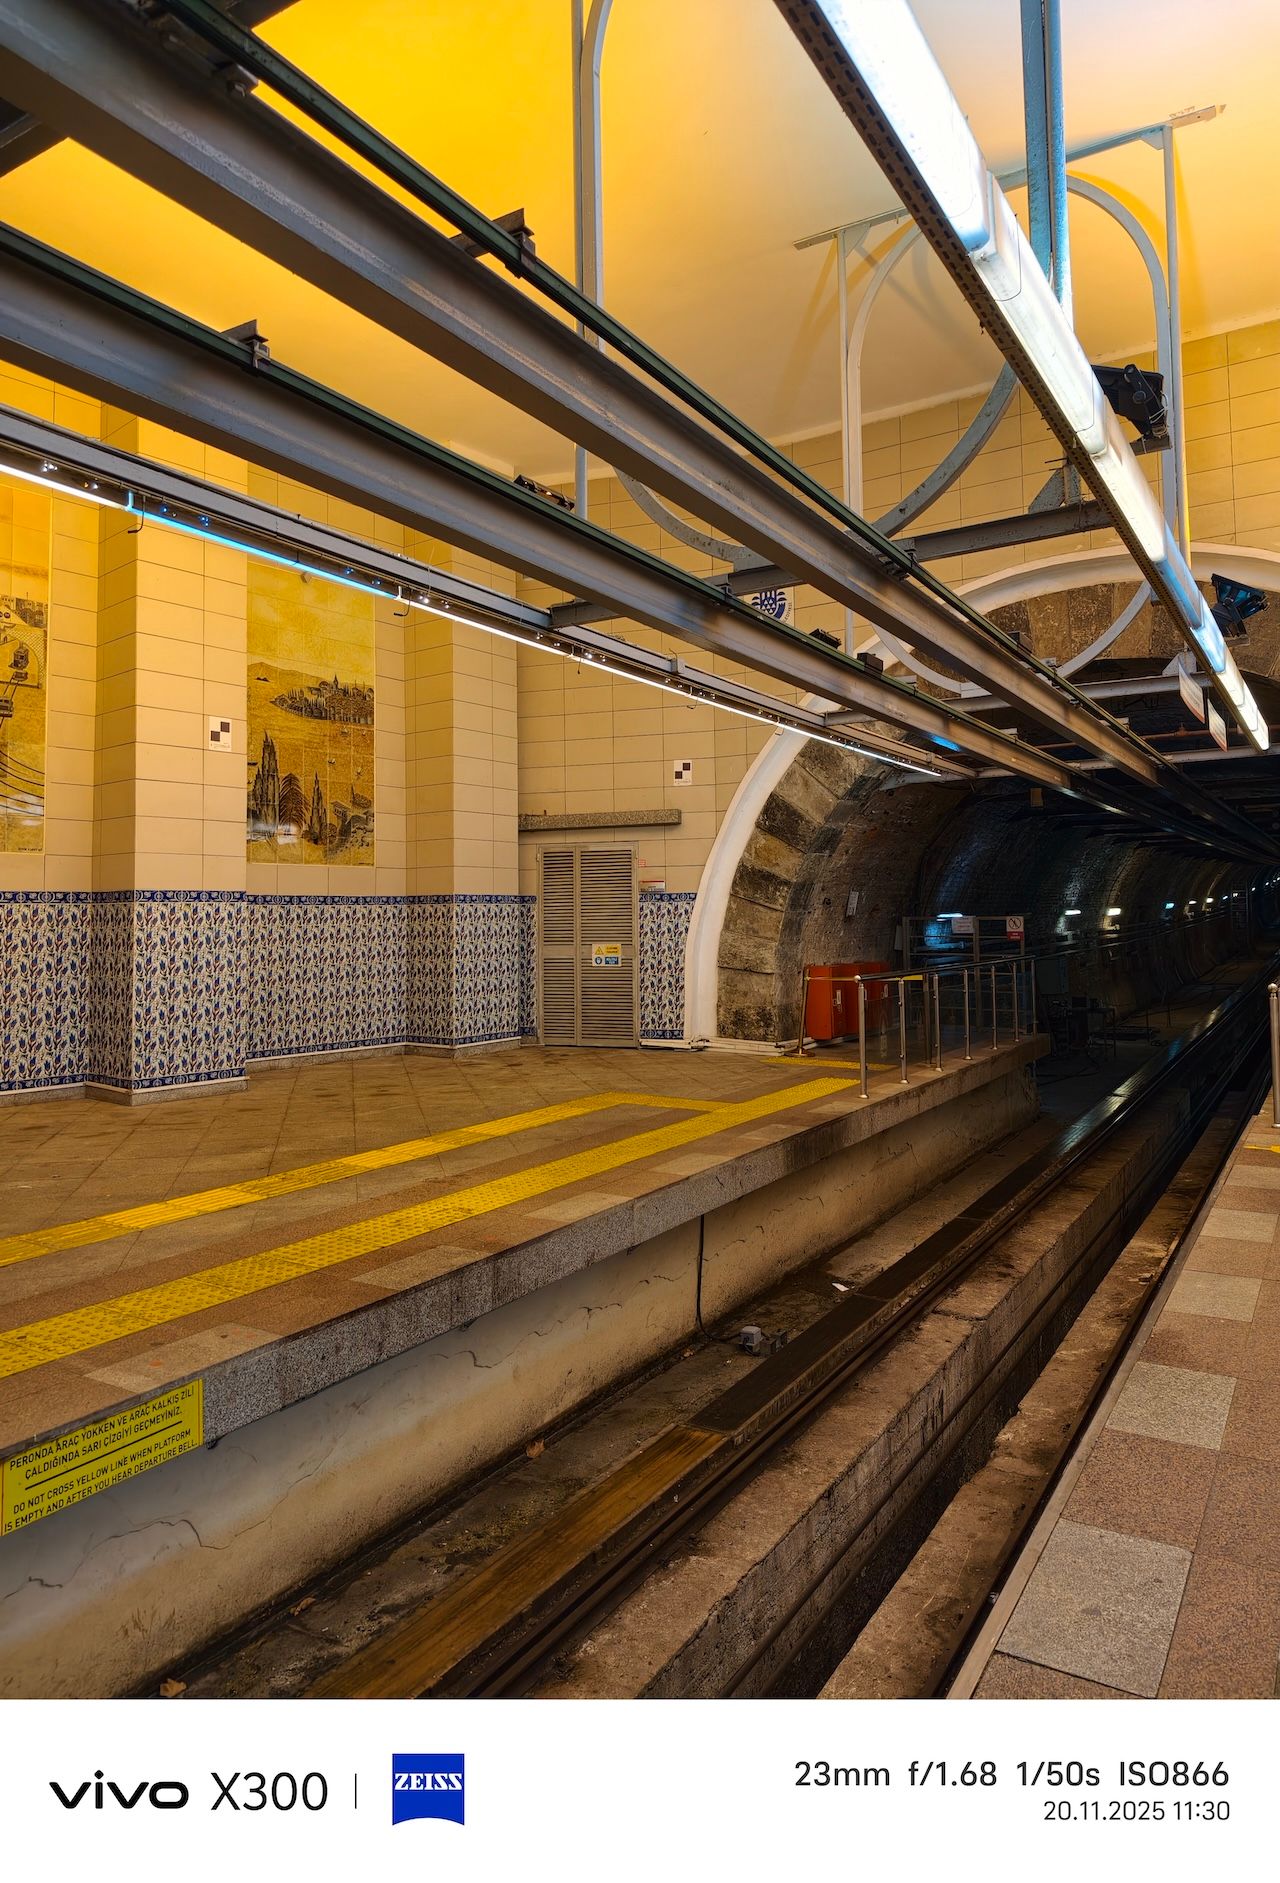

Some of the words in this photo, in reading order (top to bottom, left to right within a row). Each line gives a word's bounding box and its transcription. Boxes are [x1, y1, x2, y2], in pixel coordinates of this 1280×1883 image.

[10, 1446, 54, 1471] PERONDA
[56, 1435, 79, 1453] ARAÇ
[81, 1420, 115, 1441] YOKKEN
[117, 1415, 127, 1426] VE
[130, 1406, 151, 1422] ARAÇ
[152, 1393, 180, 1412] KALKIŞ
[14, 1502, 26, 1515] DO
[28, 1493, 45, 1508] NOT
[47, 1480, 74, 1500] CROSS
[76, 1465, 109, 1486] YELLOW
[110, 1455, 128, 1472] LINE
[130, 1446, 153, 1463] WHEN
[155, 1428, 191, 1452] PLATFORM
[25, 1450, 80, 1480] ÇALDIĞINDA
[82, 1440, 102, 1456] SARI
[103, 1424, 132, 1448] ÇİZGİYİ
[134, 1406, 182, 1433] GEÇMEYİNİZ.
[4, 1521, 13, 1533] IS
[15, 1507, 44, 1528] EMPTY
[46, 1498, 64, 1515] AND
[66, 1486, 93, 1504] AFTER
[94, 1477, 110, 1493] YOU
[112, 1467, 133, 1484] HEAR
[135, 1447, 177, 1474] DEPARTURE
[179, 1439, 198, 1453] BELL.
